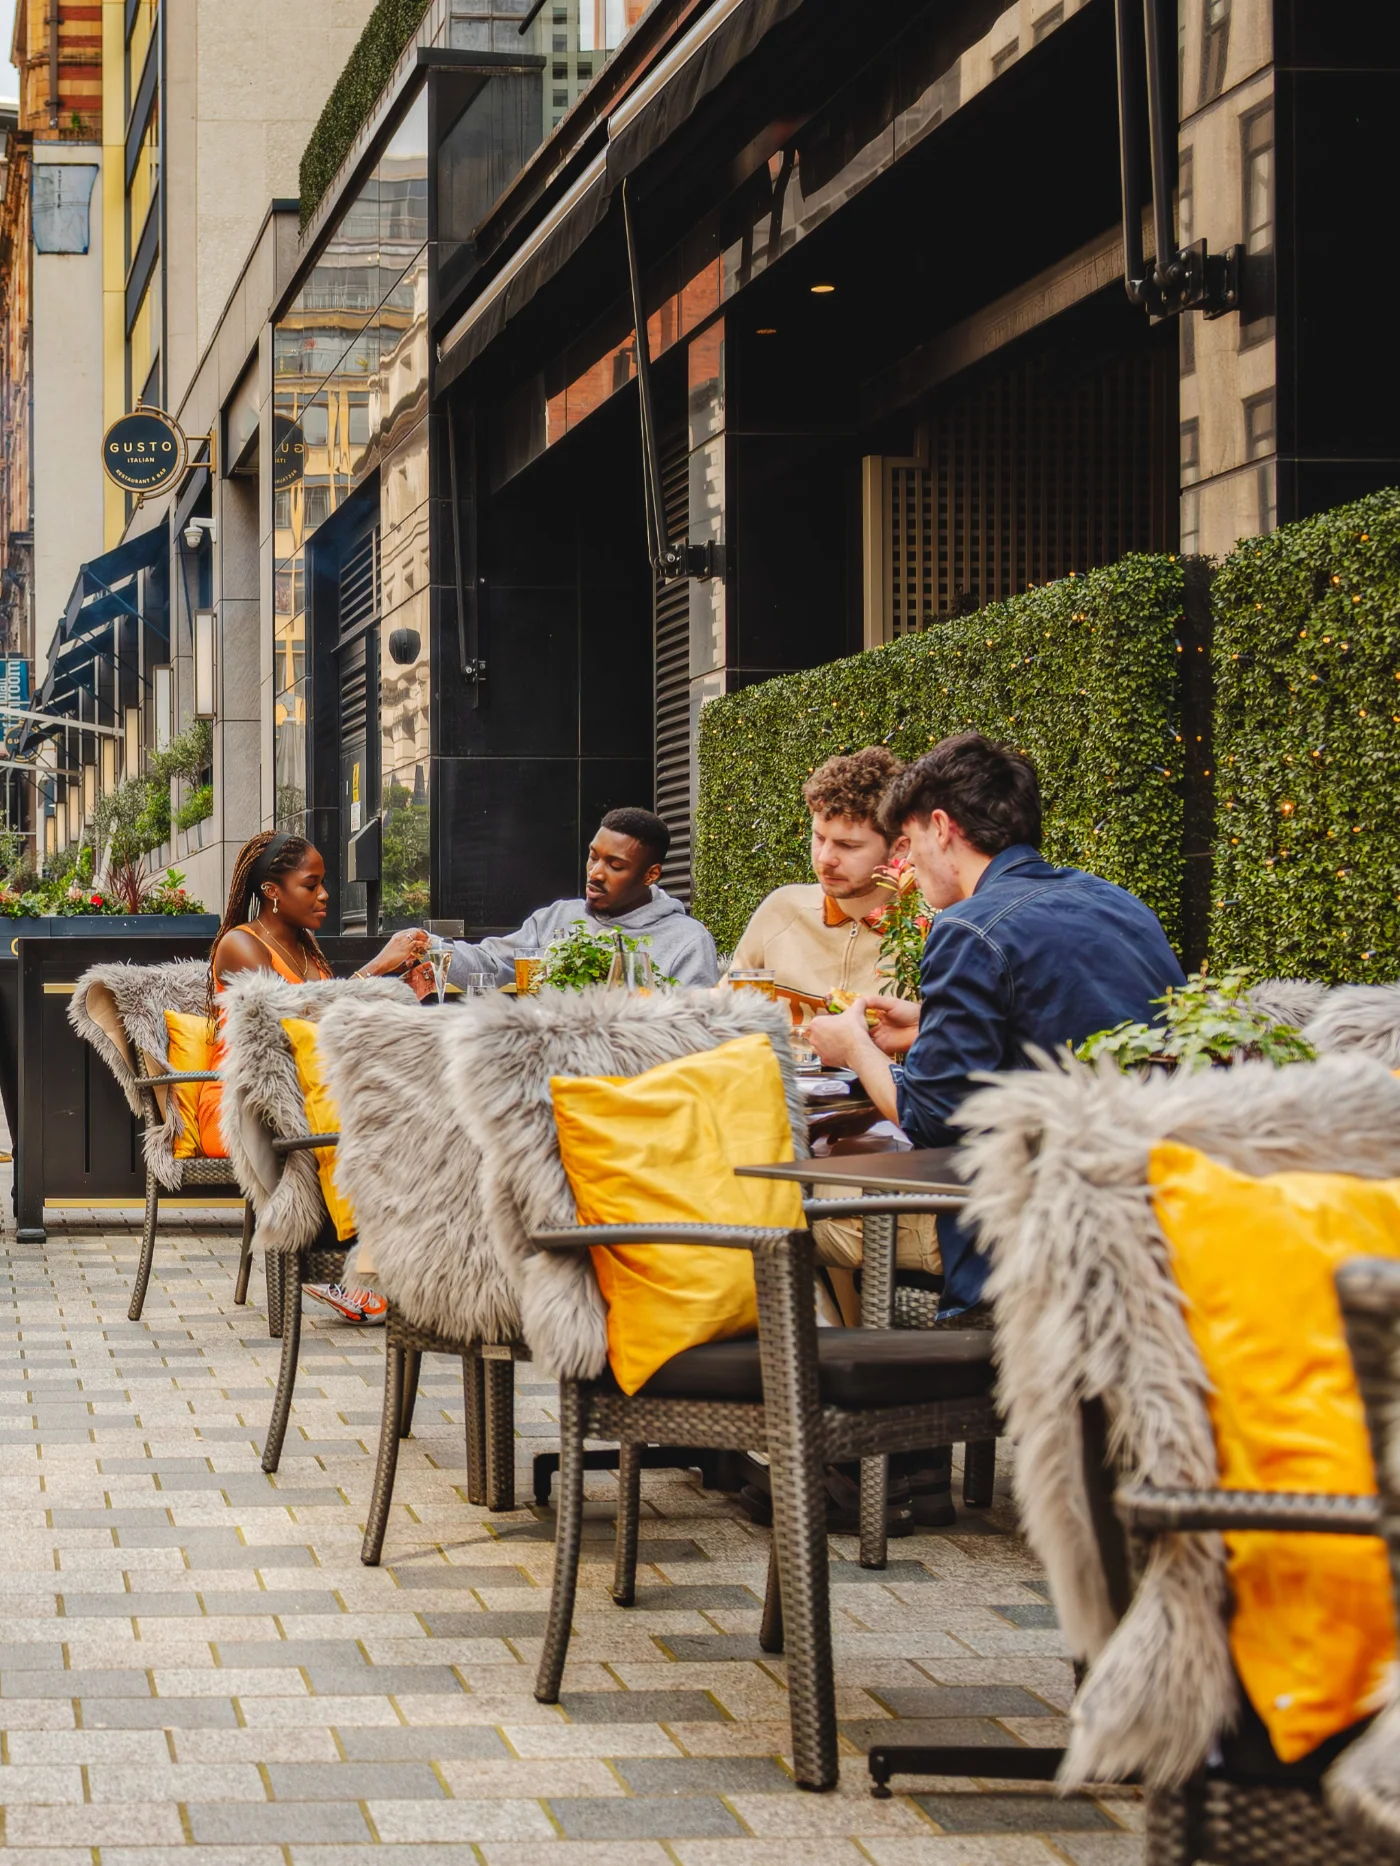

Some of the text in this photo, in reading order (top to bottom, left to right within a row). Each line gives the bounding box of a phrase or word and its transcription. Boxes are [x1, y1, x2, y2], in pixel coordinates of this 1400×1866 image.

[109, 441, 172, 453] GUSTO
[115, 468, 151, 484] RESTAURANT
[156, 467, 167, 479] BAR
